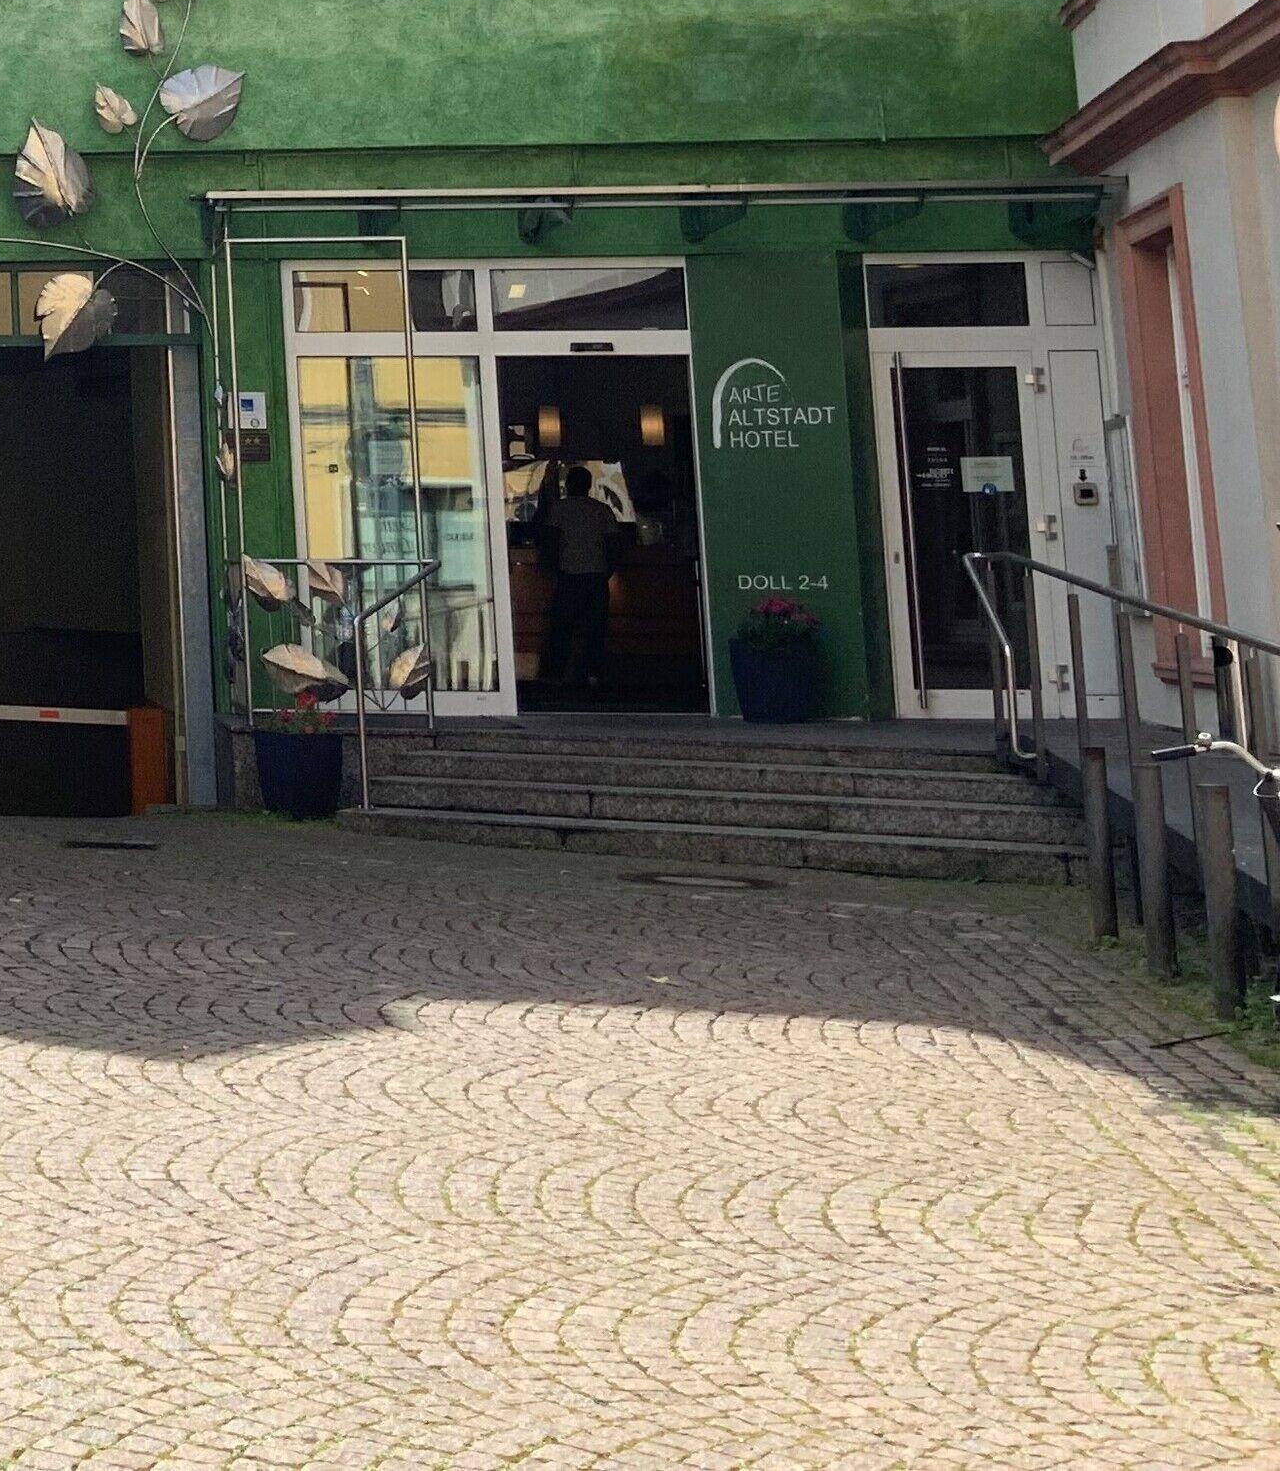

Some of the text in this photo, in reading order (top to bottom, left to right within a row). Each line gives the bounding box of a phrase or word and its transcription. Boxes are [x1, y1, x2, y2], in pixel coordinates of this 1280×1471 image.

[728, 383, 781, 404] ARTE
[727, 406, 836, 427] ALTSTADT
[729, 429, 800, 449] HOTEL
[738, 574, 829, 590] DOLL 2-4
